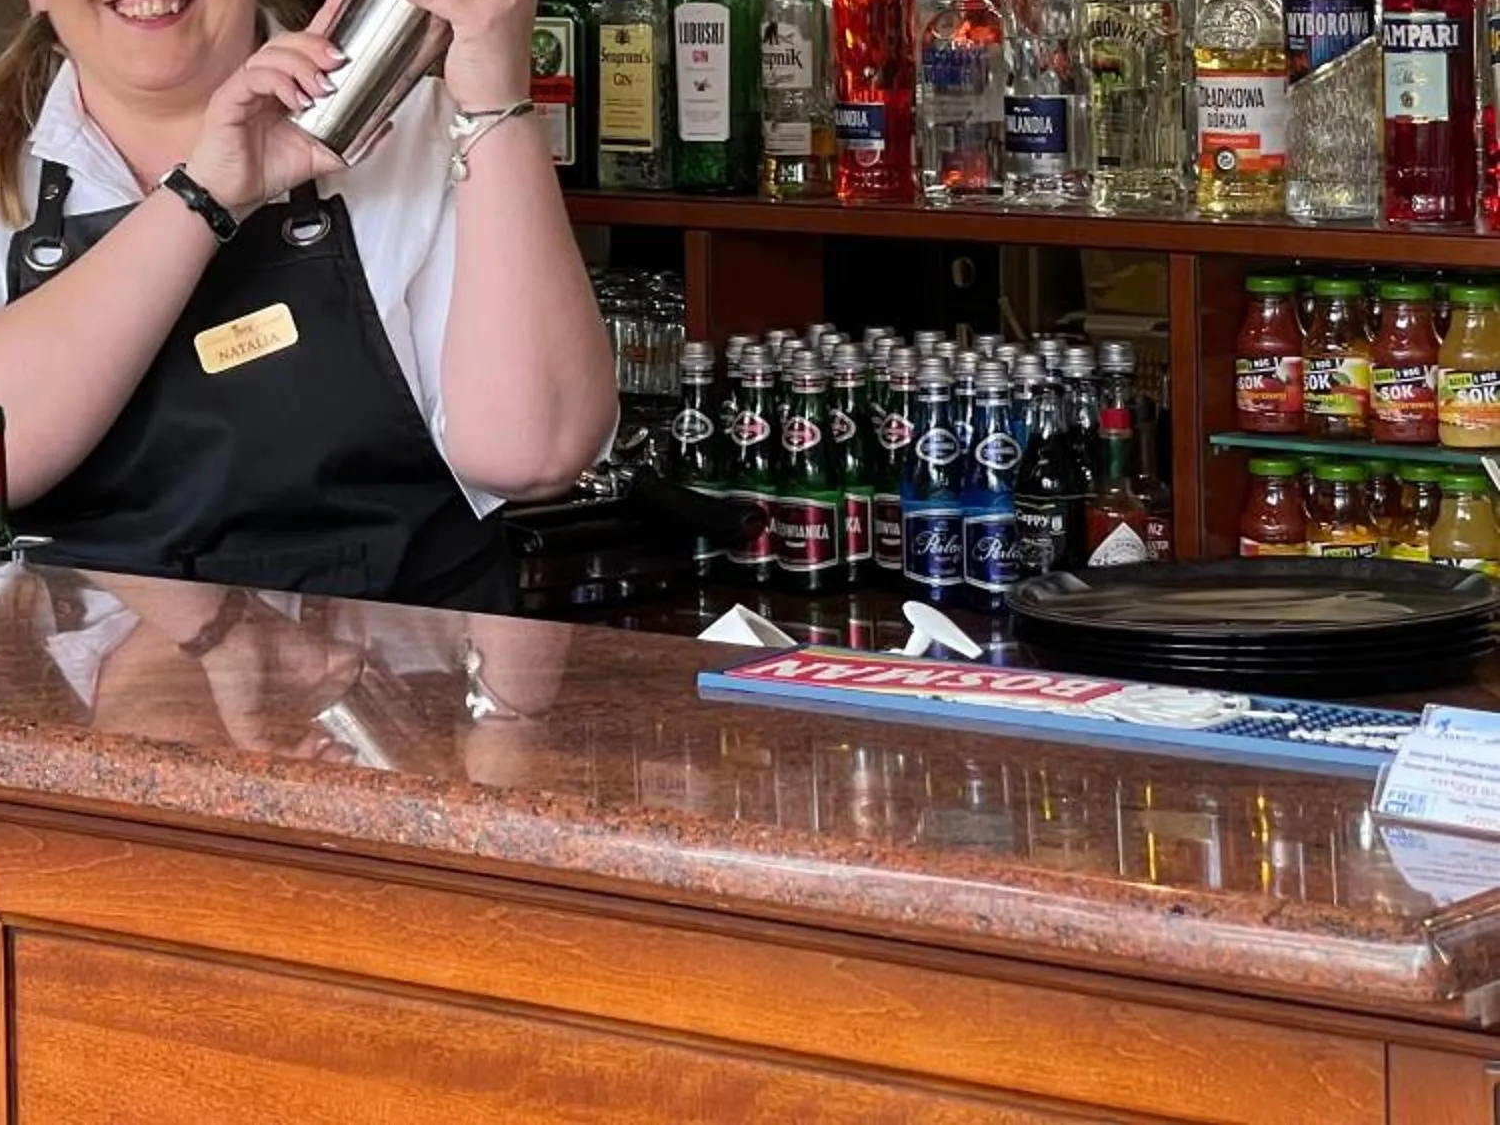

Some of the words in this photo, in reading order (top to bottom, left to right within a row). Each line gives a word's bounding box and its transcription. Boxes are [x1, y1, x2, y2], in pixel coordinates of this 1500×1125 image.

[1285, 11, 1370, 37] WYBOROWA
[1382, 23, 1459, 48] AMPARI
[218, 332, 282, 362] NATALIA
[1380, 383, 1415, 401] SOK
[1457, 385, 1498, 404] SOK
[754, 658, 1113, 698] BOSMAN
